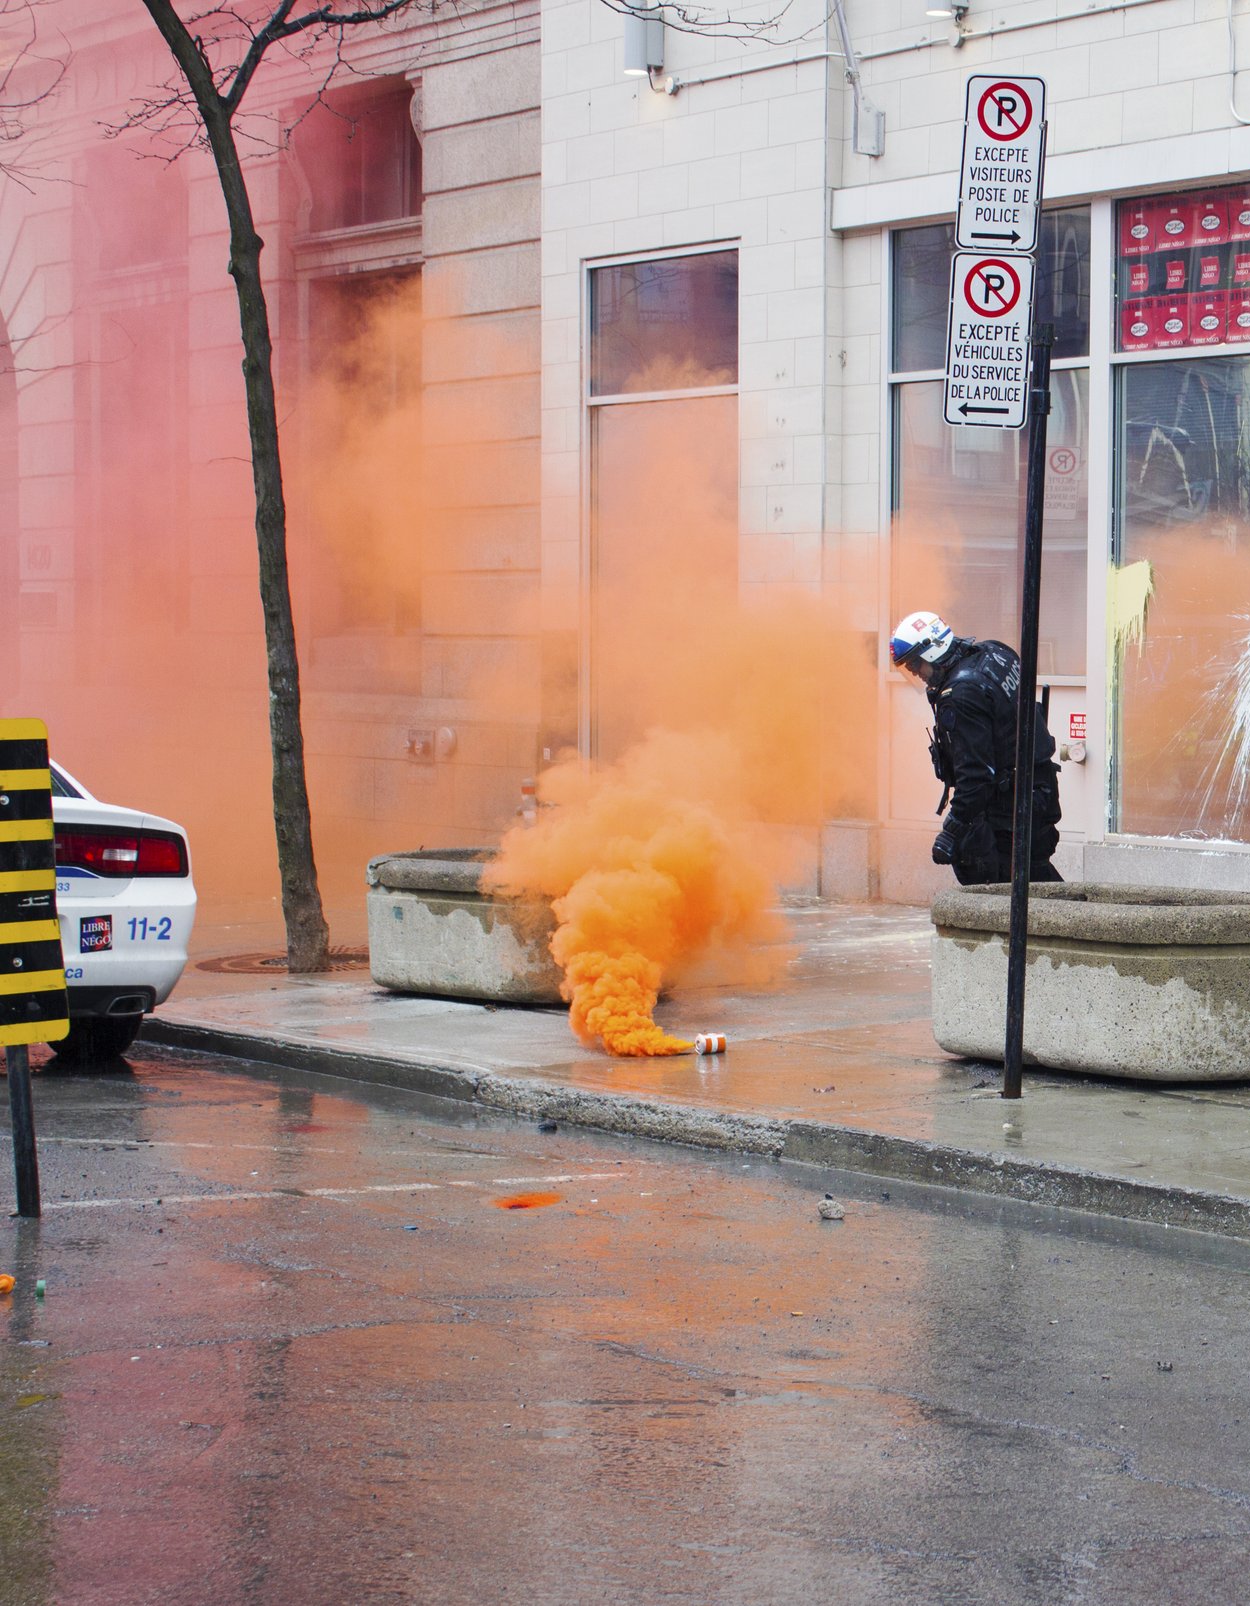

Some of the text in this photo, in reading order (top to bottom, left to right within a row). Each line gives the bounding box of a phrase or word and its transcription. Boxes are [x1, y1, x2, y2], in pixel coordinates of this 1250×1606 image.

[970, 166, 1032, 183] VISITEURS
[968, 186, 1029, 203] POSTE DE
[975, 207, 1020, 223] POLICE
[959, 322, 1020, 342] EXCEPTÉ
[955, 341, 1023, 362] VÉHICULES
[953, 364, 1021, 381] DU SERVICE
[951, 384, 1021, 402] DE LA POLICE
[82, 921, 111, 934] LIBRE
[127, 916, 172, 940] 11-2
[82, 934, 111, 947] NÉGO
[64, 967, 83, 979] ca
